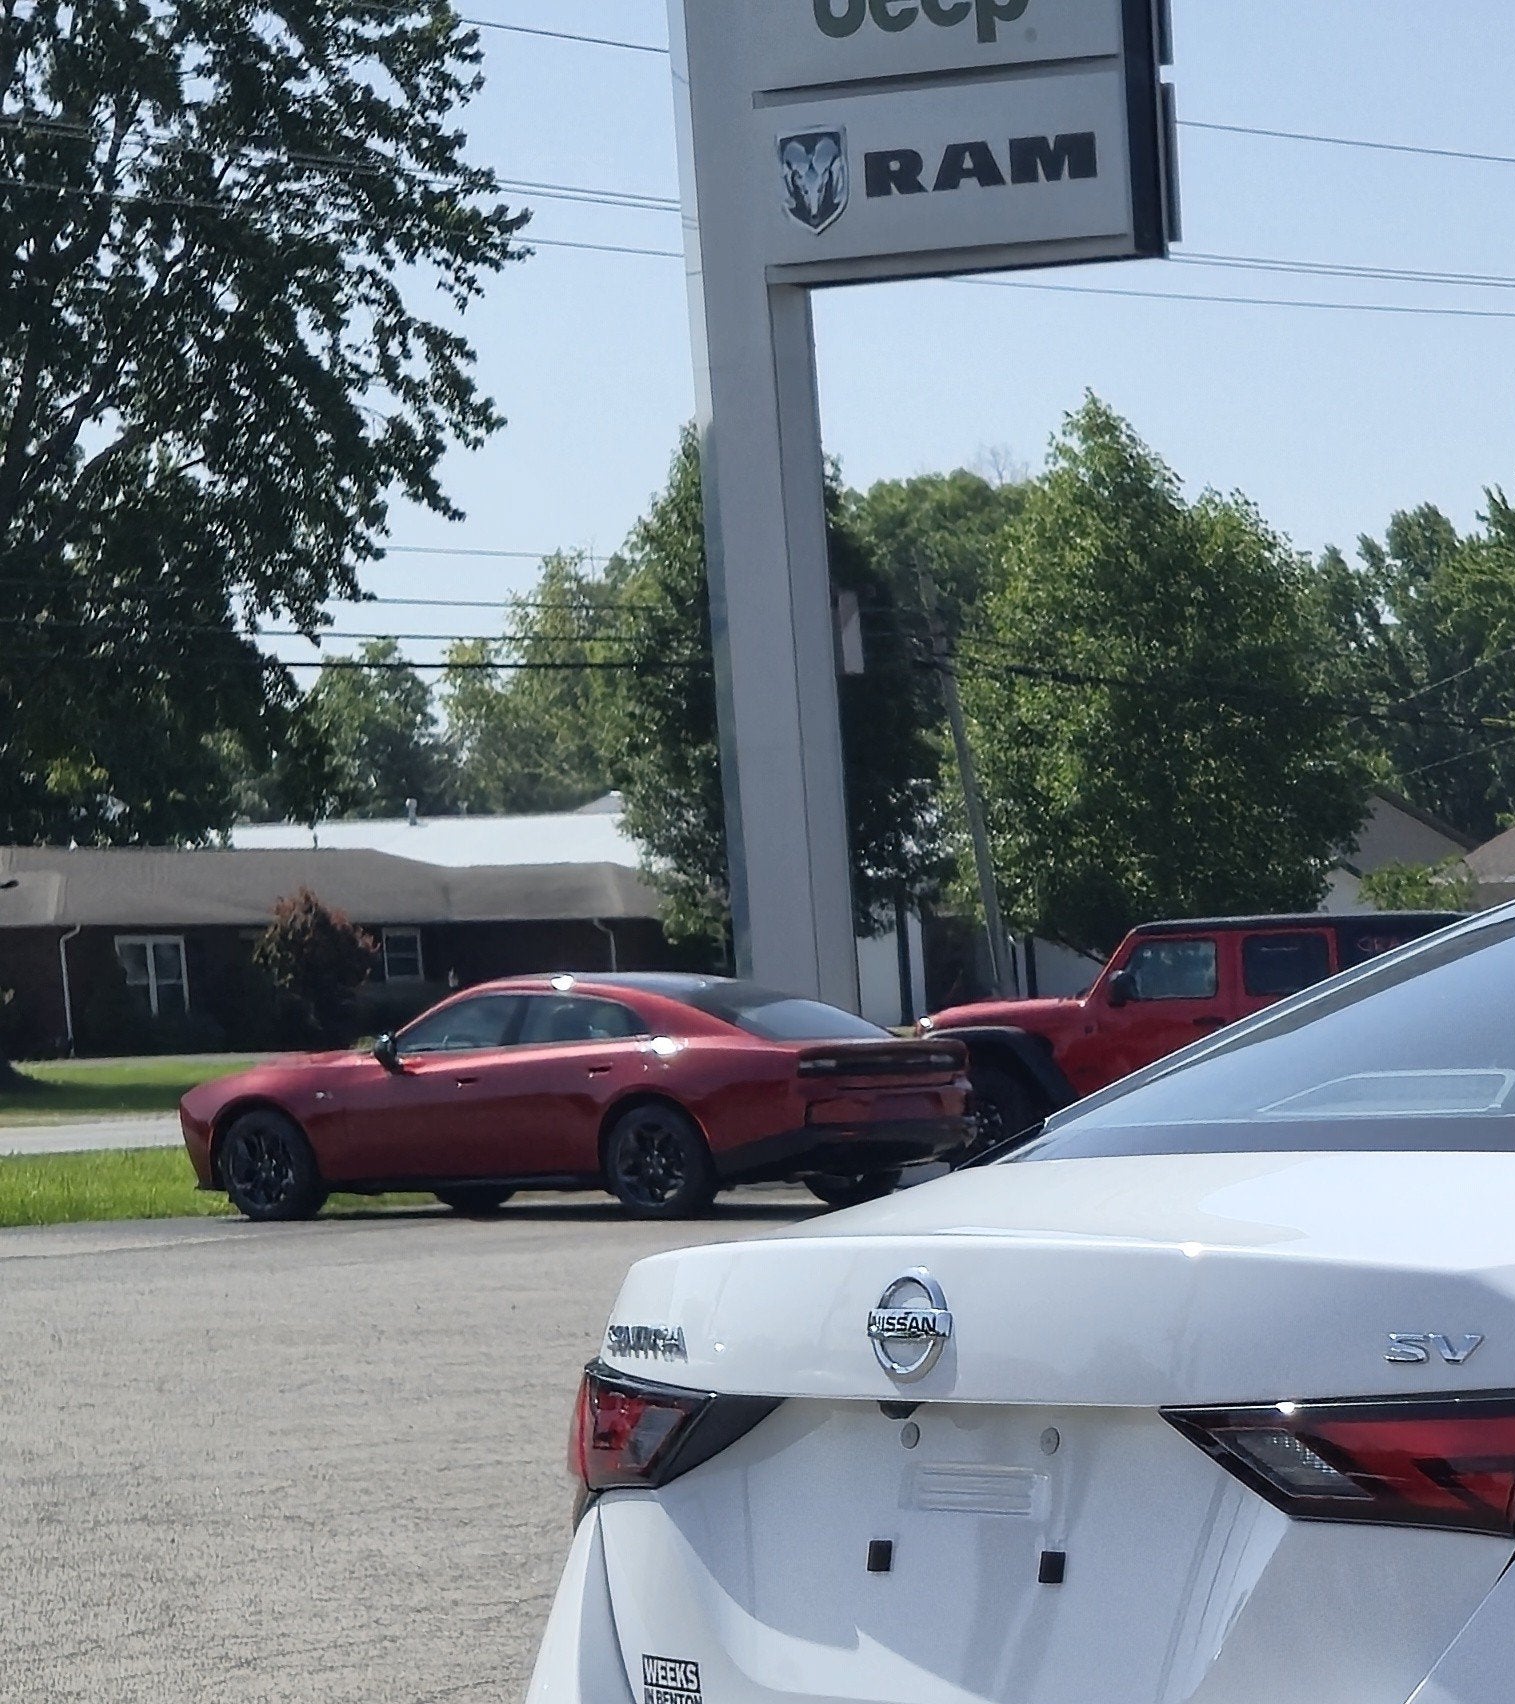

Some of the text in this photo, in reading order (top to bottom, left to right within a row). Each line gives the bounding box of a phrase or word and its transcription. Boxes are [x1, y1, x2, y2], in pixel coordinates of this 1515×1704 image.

[864, 131, 1097, 198] RAM
[871, 1314, 936, 1335] NISSAN
[1383, 1332, 1485, 1365] SV
[644, 1658, 699, 1691] WEEKS
